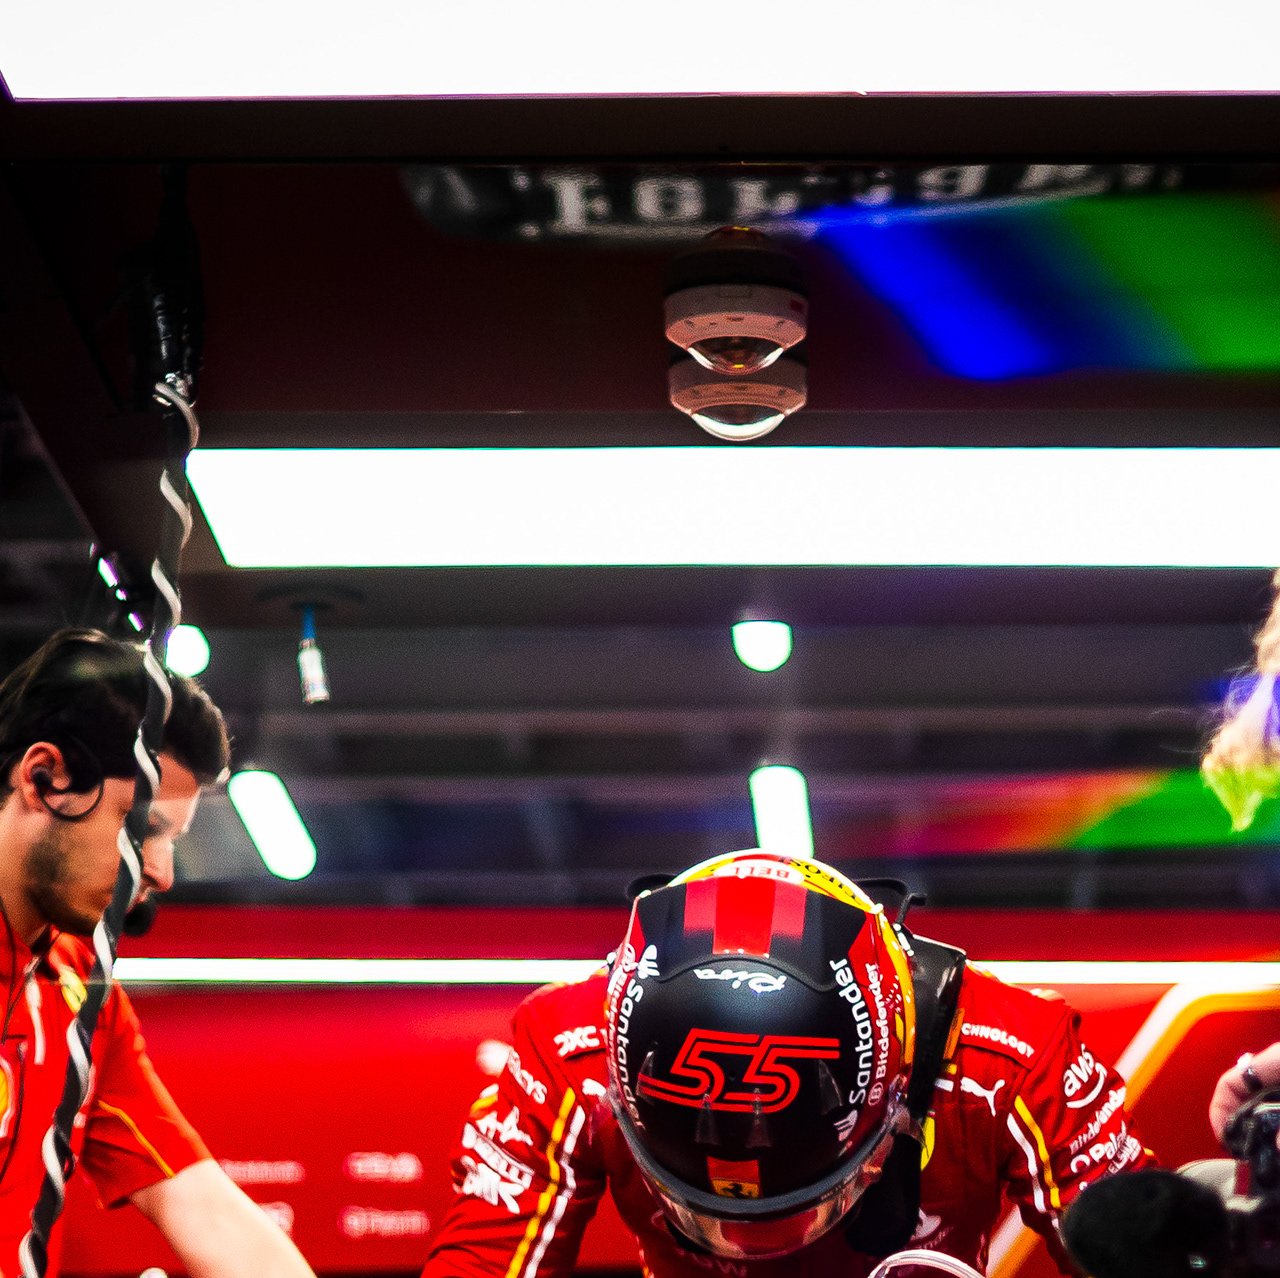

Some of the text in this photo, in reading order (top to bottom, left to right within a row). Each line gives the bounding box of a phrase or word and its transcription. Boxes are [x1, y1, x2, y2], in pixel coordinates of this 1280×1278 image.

[617, 978, 647, 1131] Santander
[637, 1027, 840, 1114] 55
[829, 958, 873, 1104] Santander
[865, 962, 890, 1079] Bitdefender
[960, 1022, 1035, 1058] CHNOLOGY
